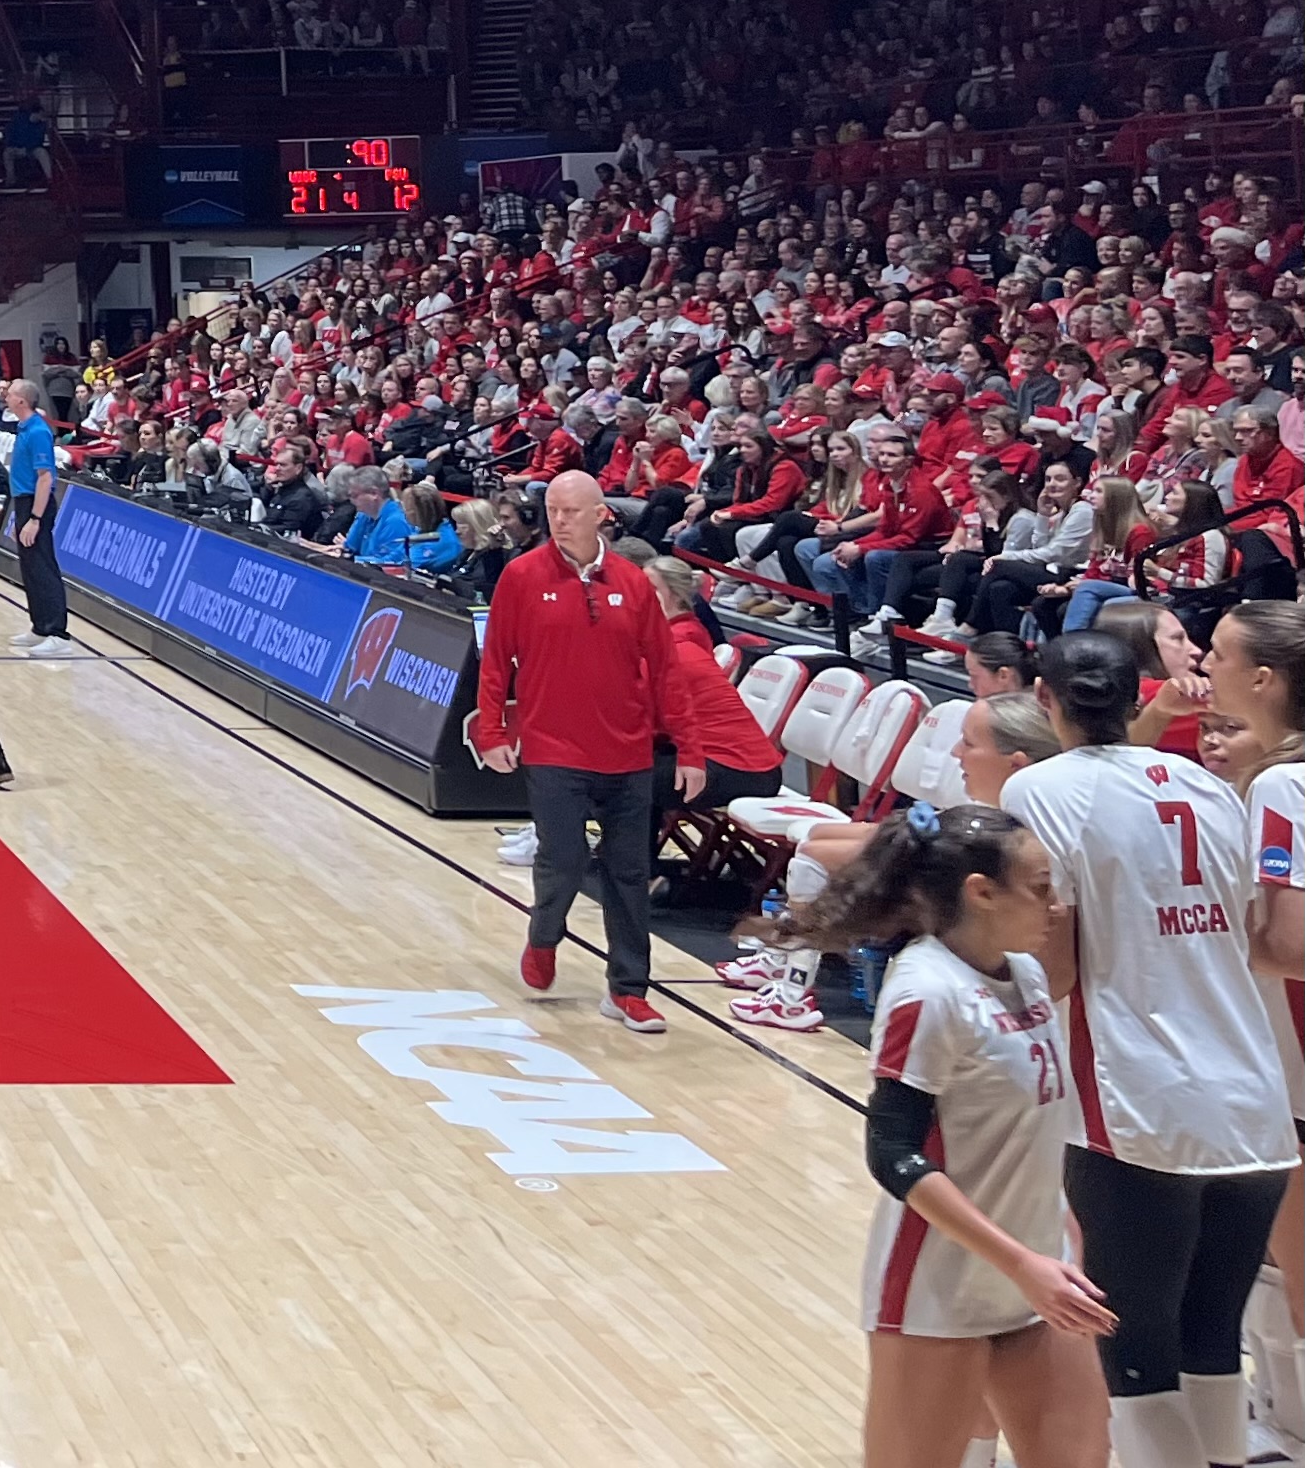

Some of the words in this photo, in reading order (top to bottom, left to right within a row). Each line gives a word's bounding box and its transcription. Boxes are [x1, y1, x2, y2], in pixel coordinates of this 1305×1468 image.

[344, 191, 359, 211] 4
[394, 184, 420, 211] 12
[60, 508, 101, 560] NCAA
[90, 519, 167, 589] REGIONALS
[228, 557, 277, 603] HOSTED
[270, 573, 298, 611] BY
[178, 580, 244, 635] UNIVERSITY
[252, 612, 332, 678] WISCONSIN
[385, 647, 460, 708] WISCONSIN
[1154, 800, 1204, 887] 7
[1030, 1037, 1066, 1106] 21
